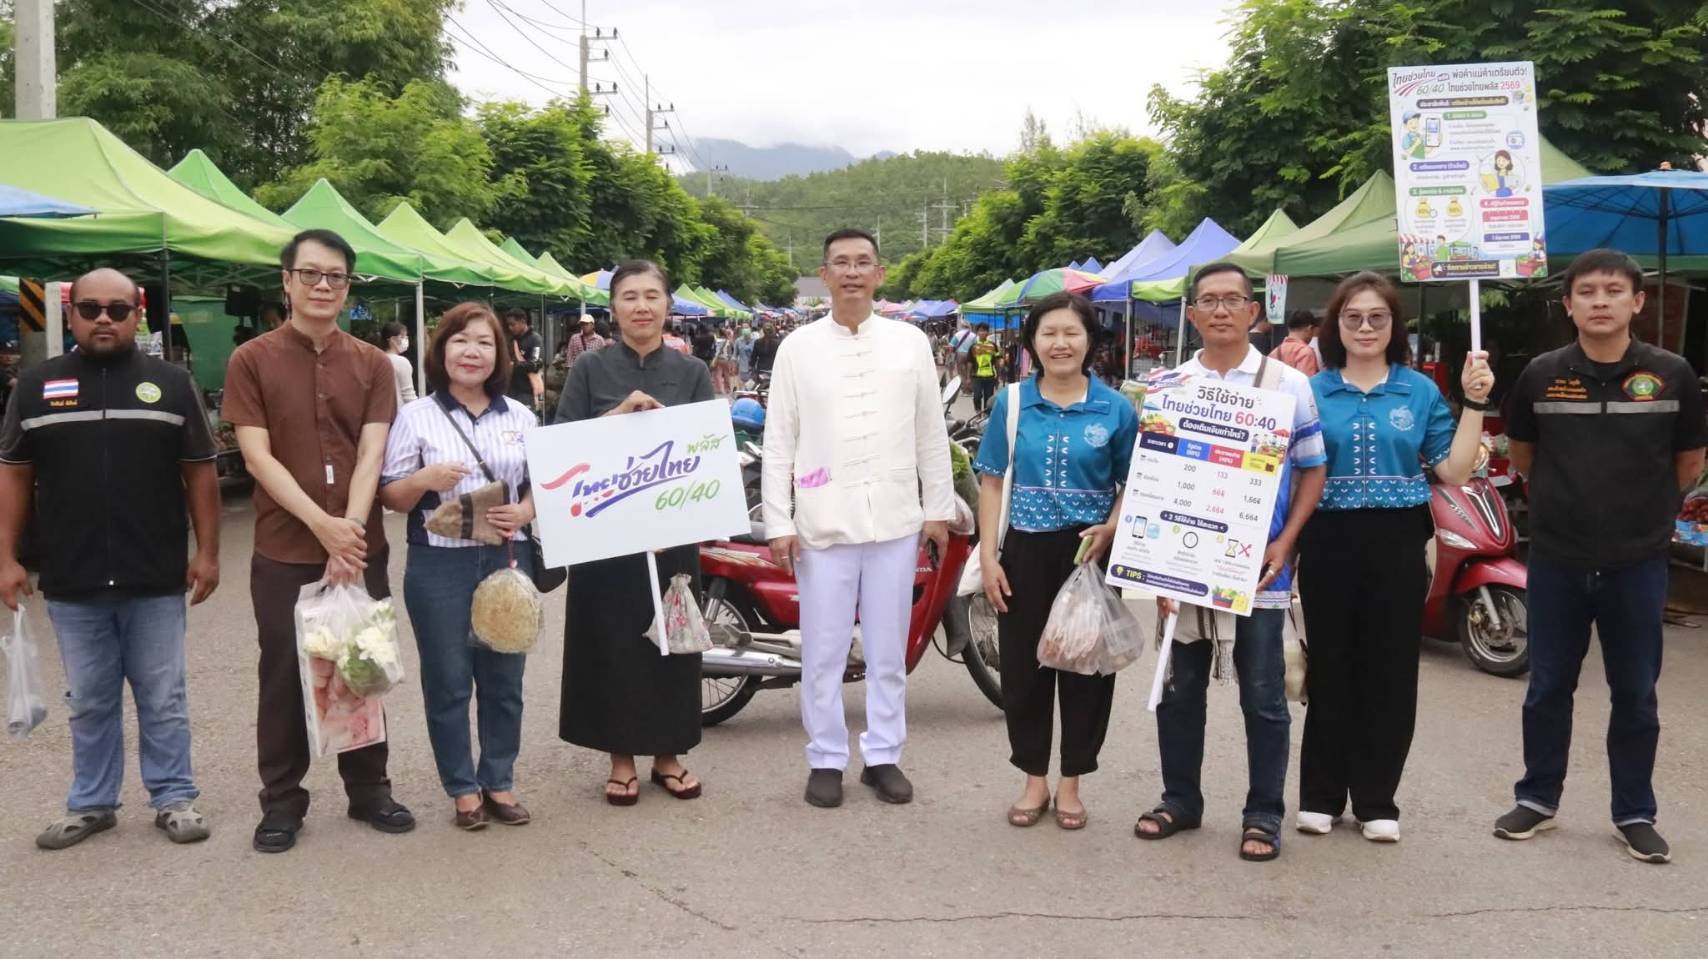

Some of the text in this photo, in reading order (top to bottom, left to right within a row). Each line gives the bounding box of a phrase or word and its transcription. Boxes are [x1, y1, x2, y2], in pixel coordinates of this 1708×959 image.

[1416, 83, 1445, 96] 60/40
[1197, 385, 1255, 410] วิธีใช้จ่าย
[1161, 393, 1277, 432] ไทยช่วยไทย 60:40
[687, 433, 729, 454] พลัส
[1183, 463, 1197, 473] 200
[1249, 477, 1262, 487] 333
[655, 478, 721, 511] 60/40
[1126, 569, 1142, 580] TIPS
